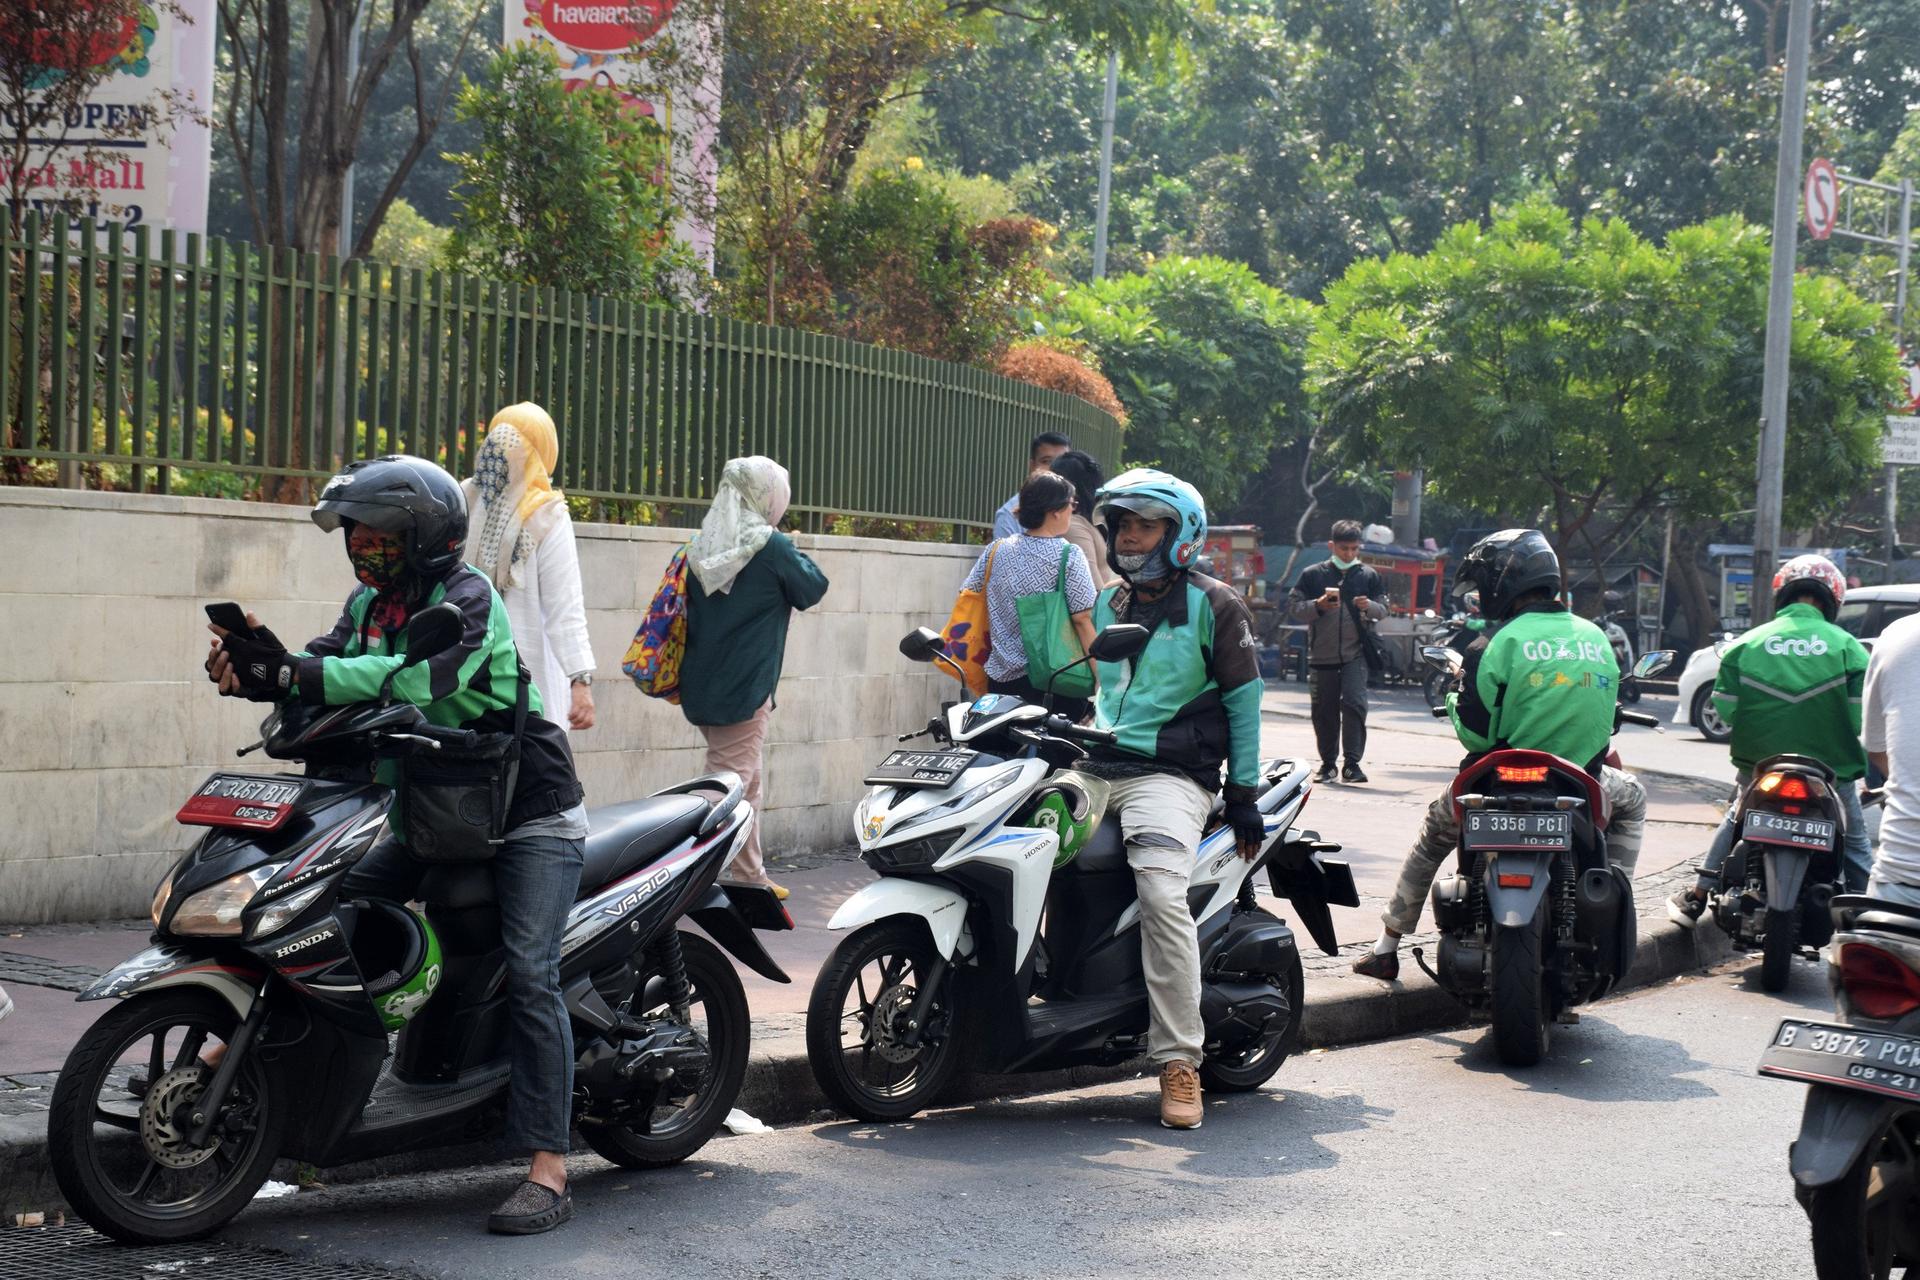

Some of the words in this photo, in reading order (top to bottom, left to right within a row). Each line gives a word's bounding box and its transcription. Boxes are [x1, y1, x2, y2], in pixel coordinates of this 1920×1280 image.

[553, 4, 652, 24] havaianas
[63, 104, 148, 131] OPEN
[68, 160, 145, 190] Mall
[123, 204, 143, 233] 2
[1765, 634, 1828, 656] Grab
[886, 754, 901, 765] B
[204, 780, 221, 796] B
[1471, 817, 1480, 831] B
[1491, 817, 1526, 832] 3358
[1752, 815, 1761, 827] B
[1806, 823, 1829, 836] BVL
[1024, 839, 1052, 860] HONDA
[602, 867, 671, 918] VARIO
[275, 930, 334, 959] HONDA
[1780, 1026, 1798, 1046] B
[1811, 1031, 1870, 1058] 3872
